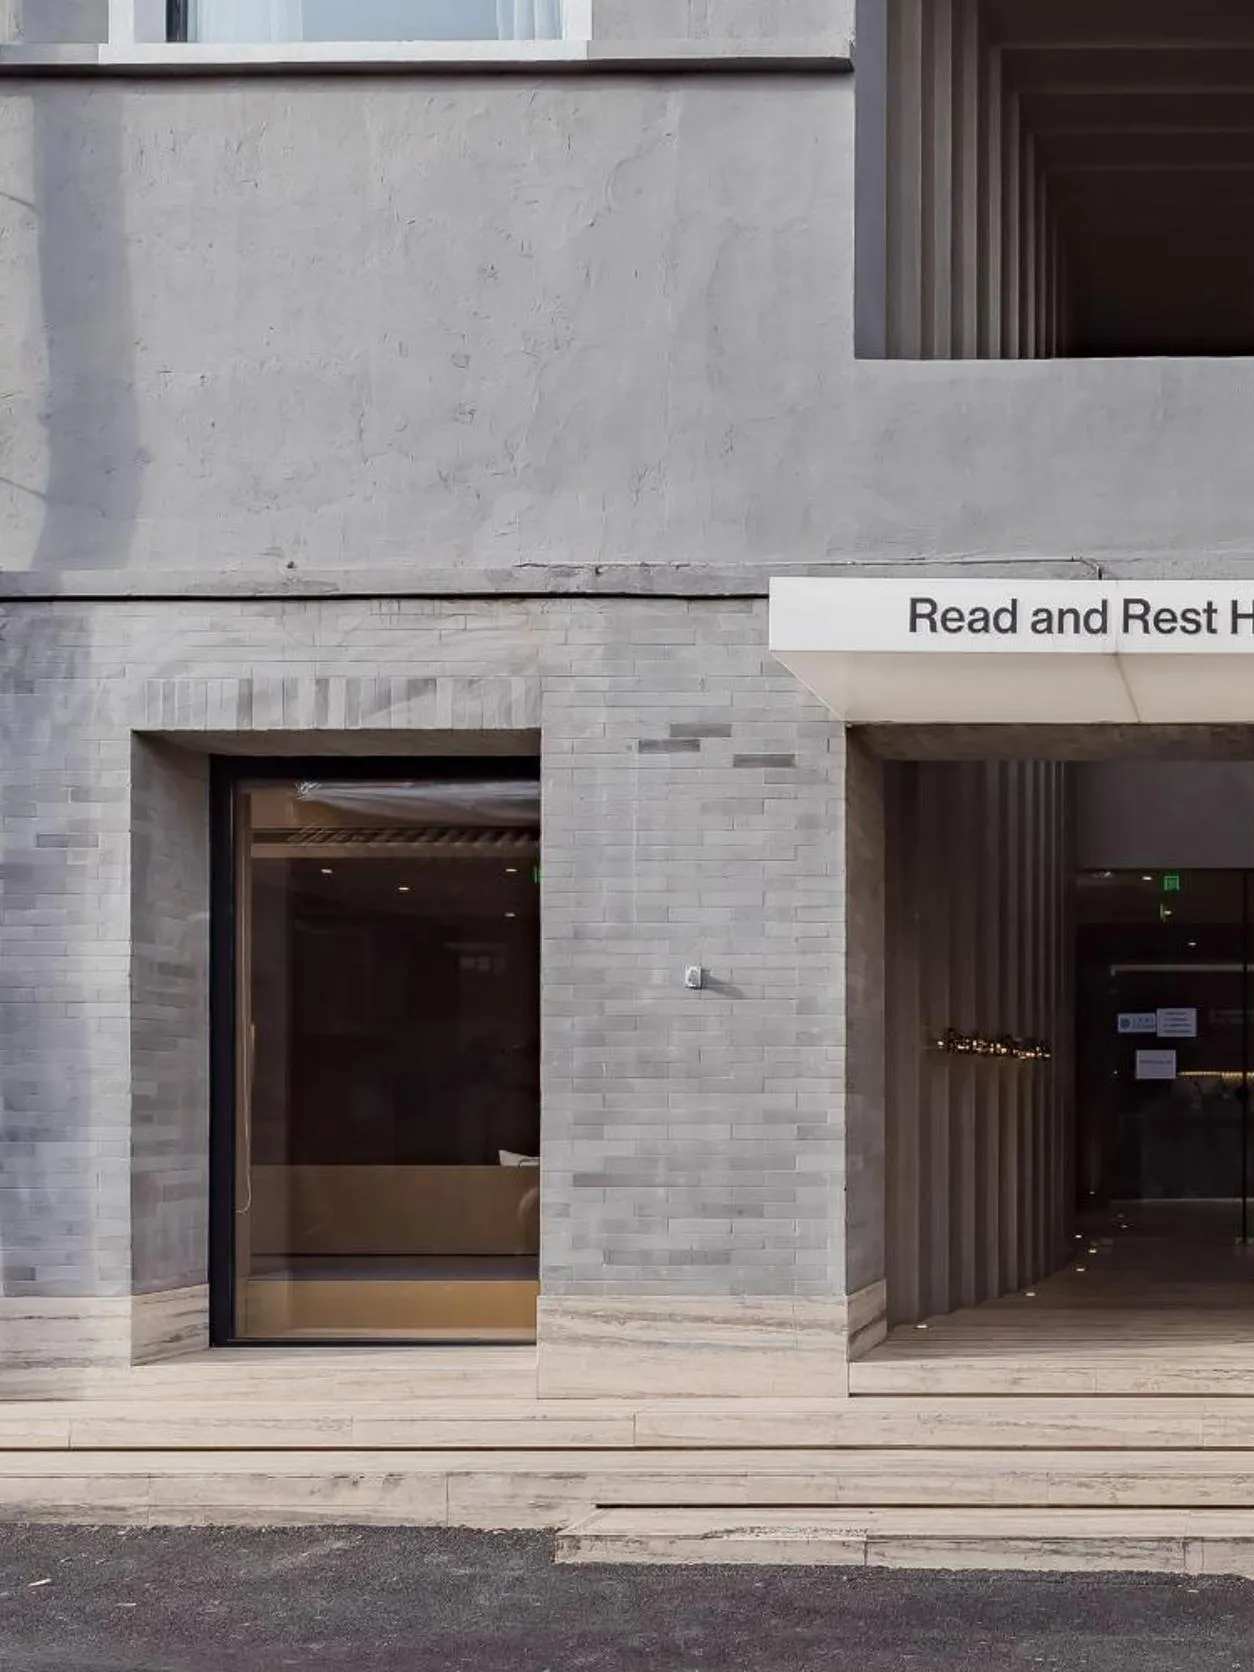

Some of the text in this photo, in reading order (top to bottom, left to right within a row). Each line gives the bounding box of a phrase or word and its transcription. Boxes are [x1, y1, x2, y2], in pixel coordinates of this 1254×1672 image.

[909, 597, 1018, 635] Read
[1030, 598, 1108, 636] and
[1122, 598, 1218, 636] Rest
